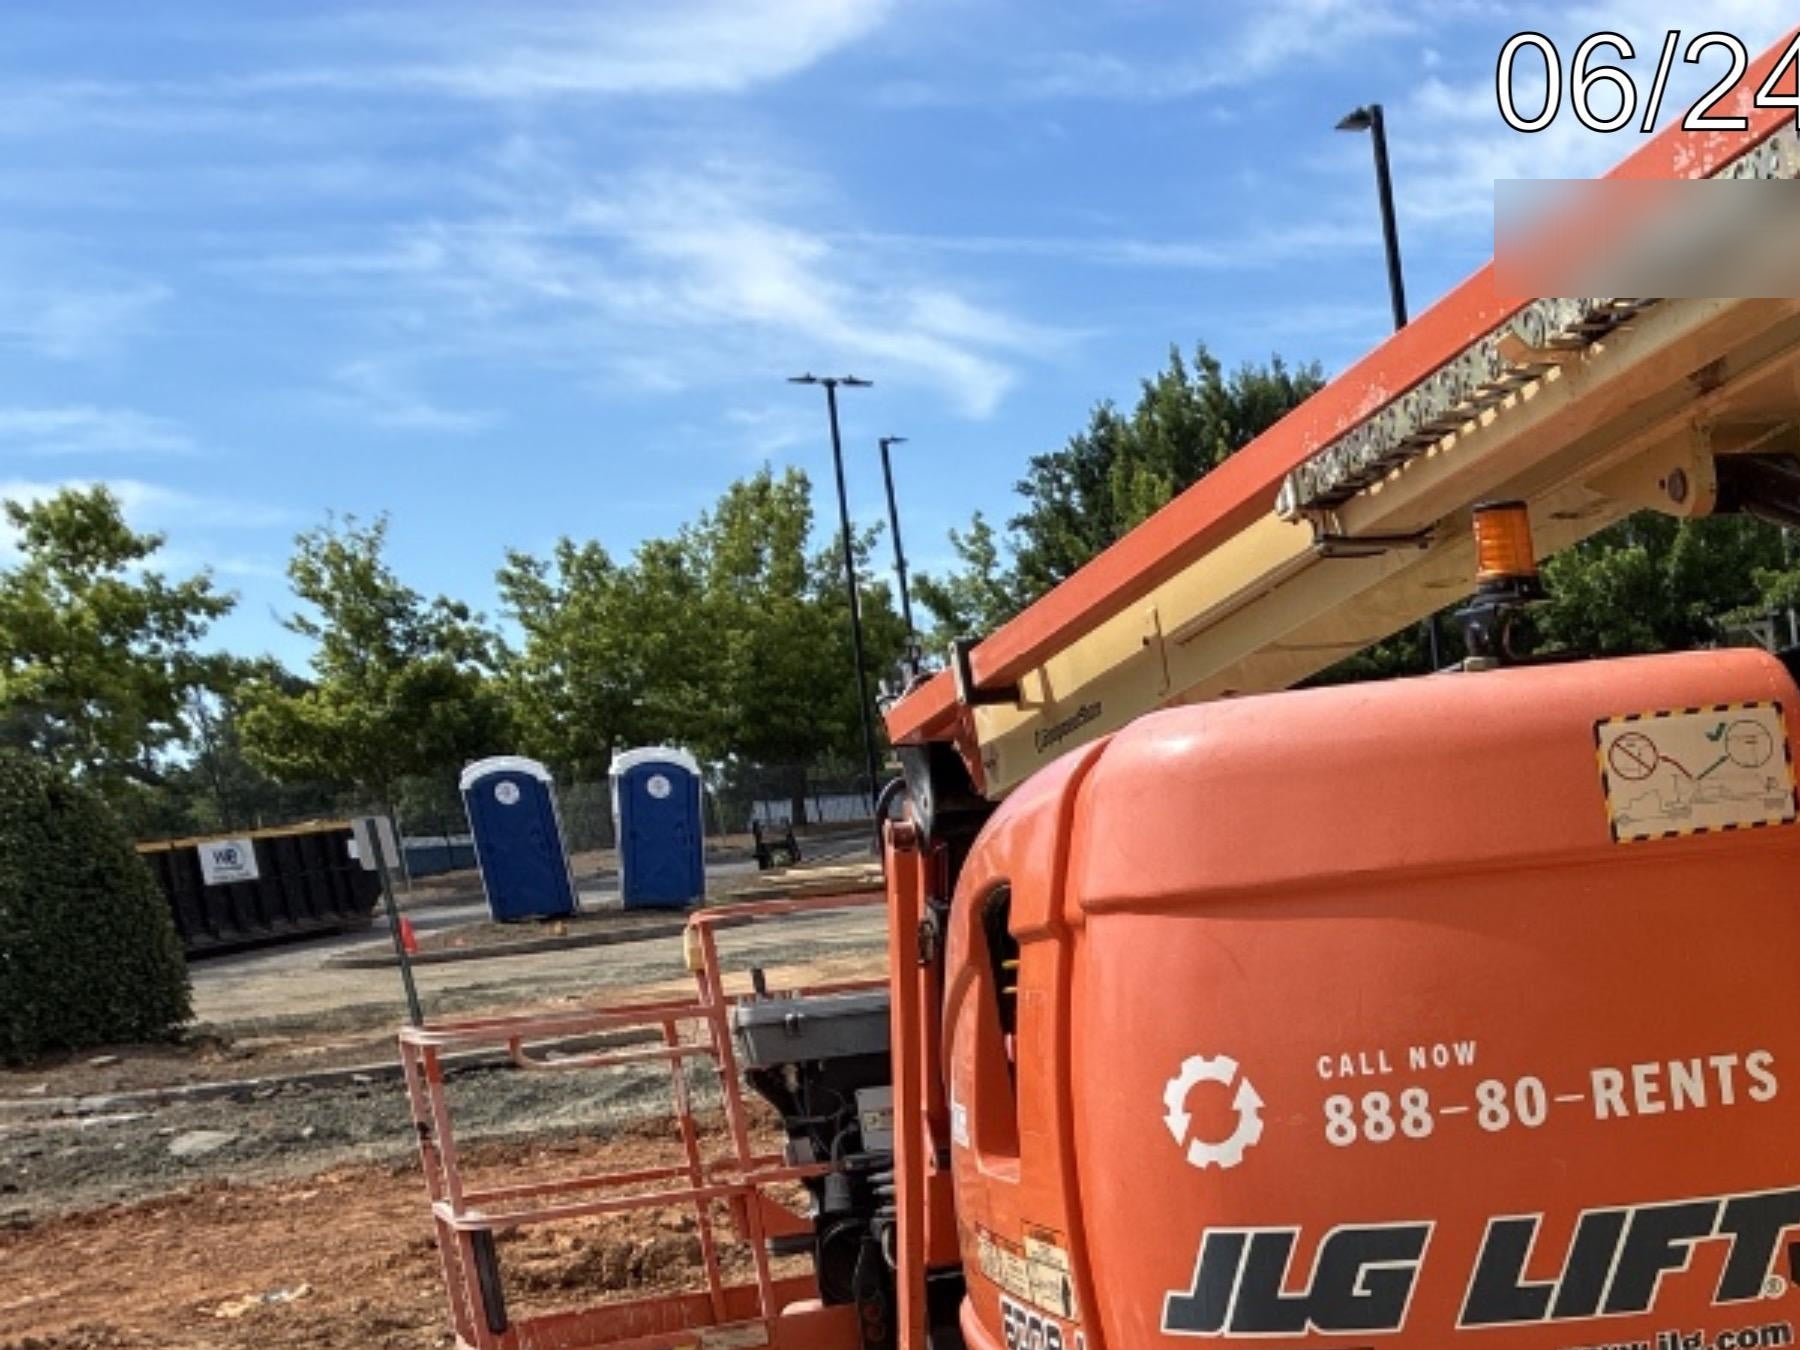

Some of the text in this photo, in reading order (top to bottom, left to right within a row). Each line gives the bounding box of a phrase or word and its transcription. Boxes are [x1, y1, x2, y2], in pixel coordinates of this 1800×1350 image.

[1317, 1040, 1477, 1080] CALL NOW
[1324, 1051, 1779, 1148] 888-80-RENTS
[1160, 1220, 1437, 1339] JLG
